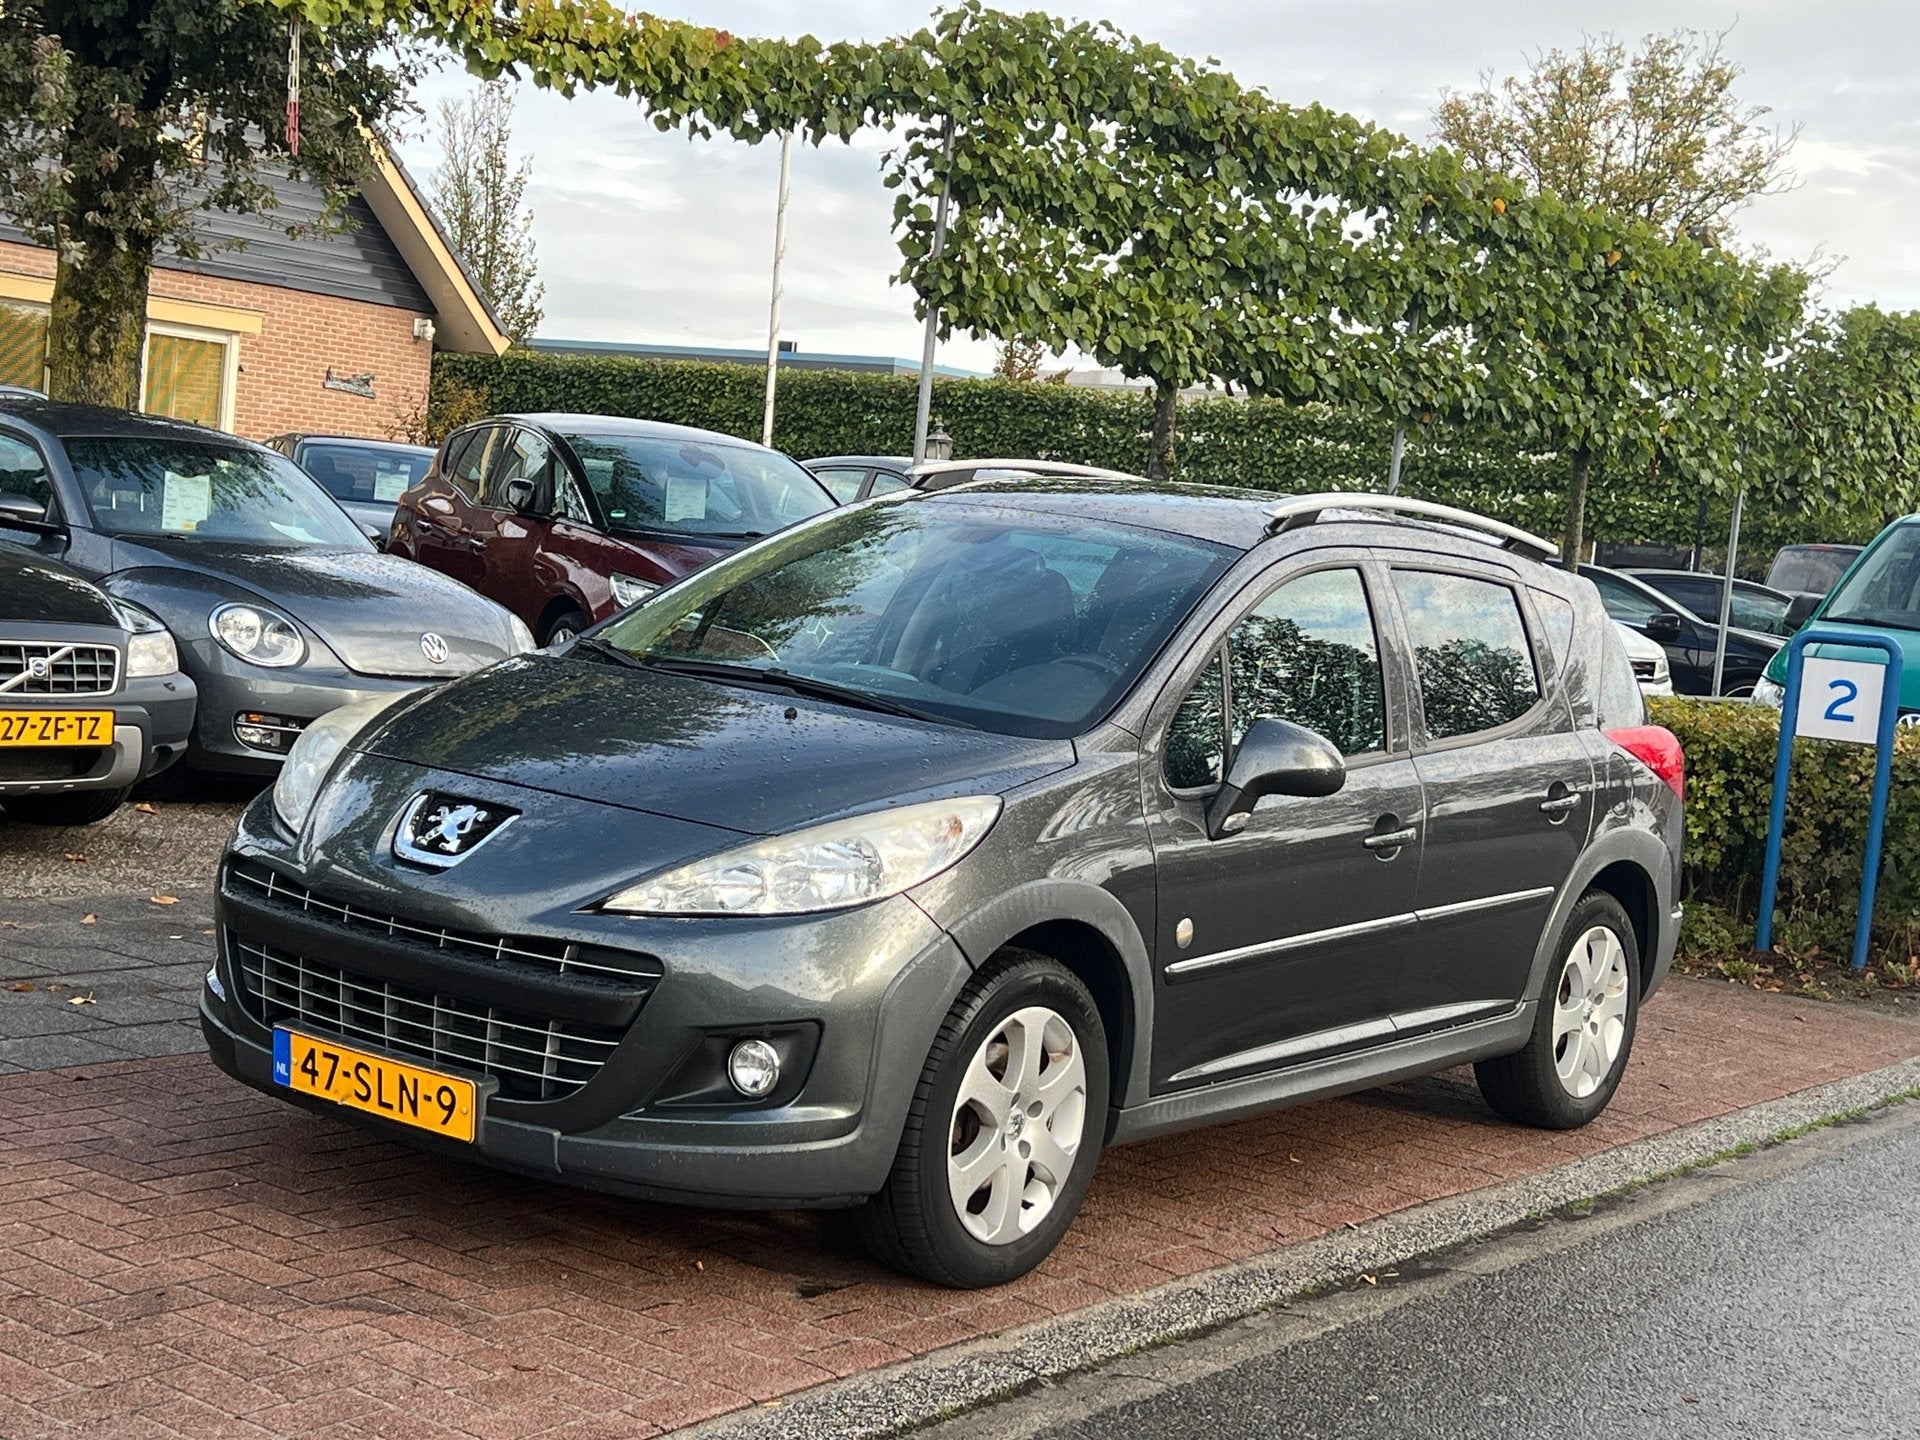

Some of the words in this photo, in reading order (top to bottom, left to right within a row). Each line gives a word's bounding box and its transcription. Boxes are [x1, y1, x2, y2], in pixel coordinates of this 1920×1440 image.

[1824, 679, 1858, 723] 2
[0, 716, 101, 740] 27-ZF-TZ
[276, 1061, 288, 1076] NL
[300, 1047, 456, 1126] 47-SLN-9
